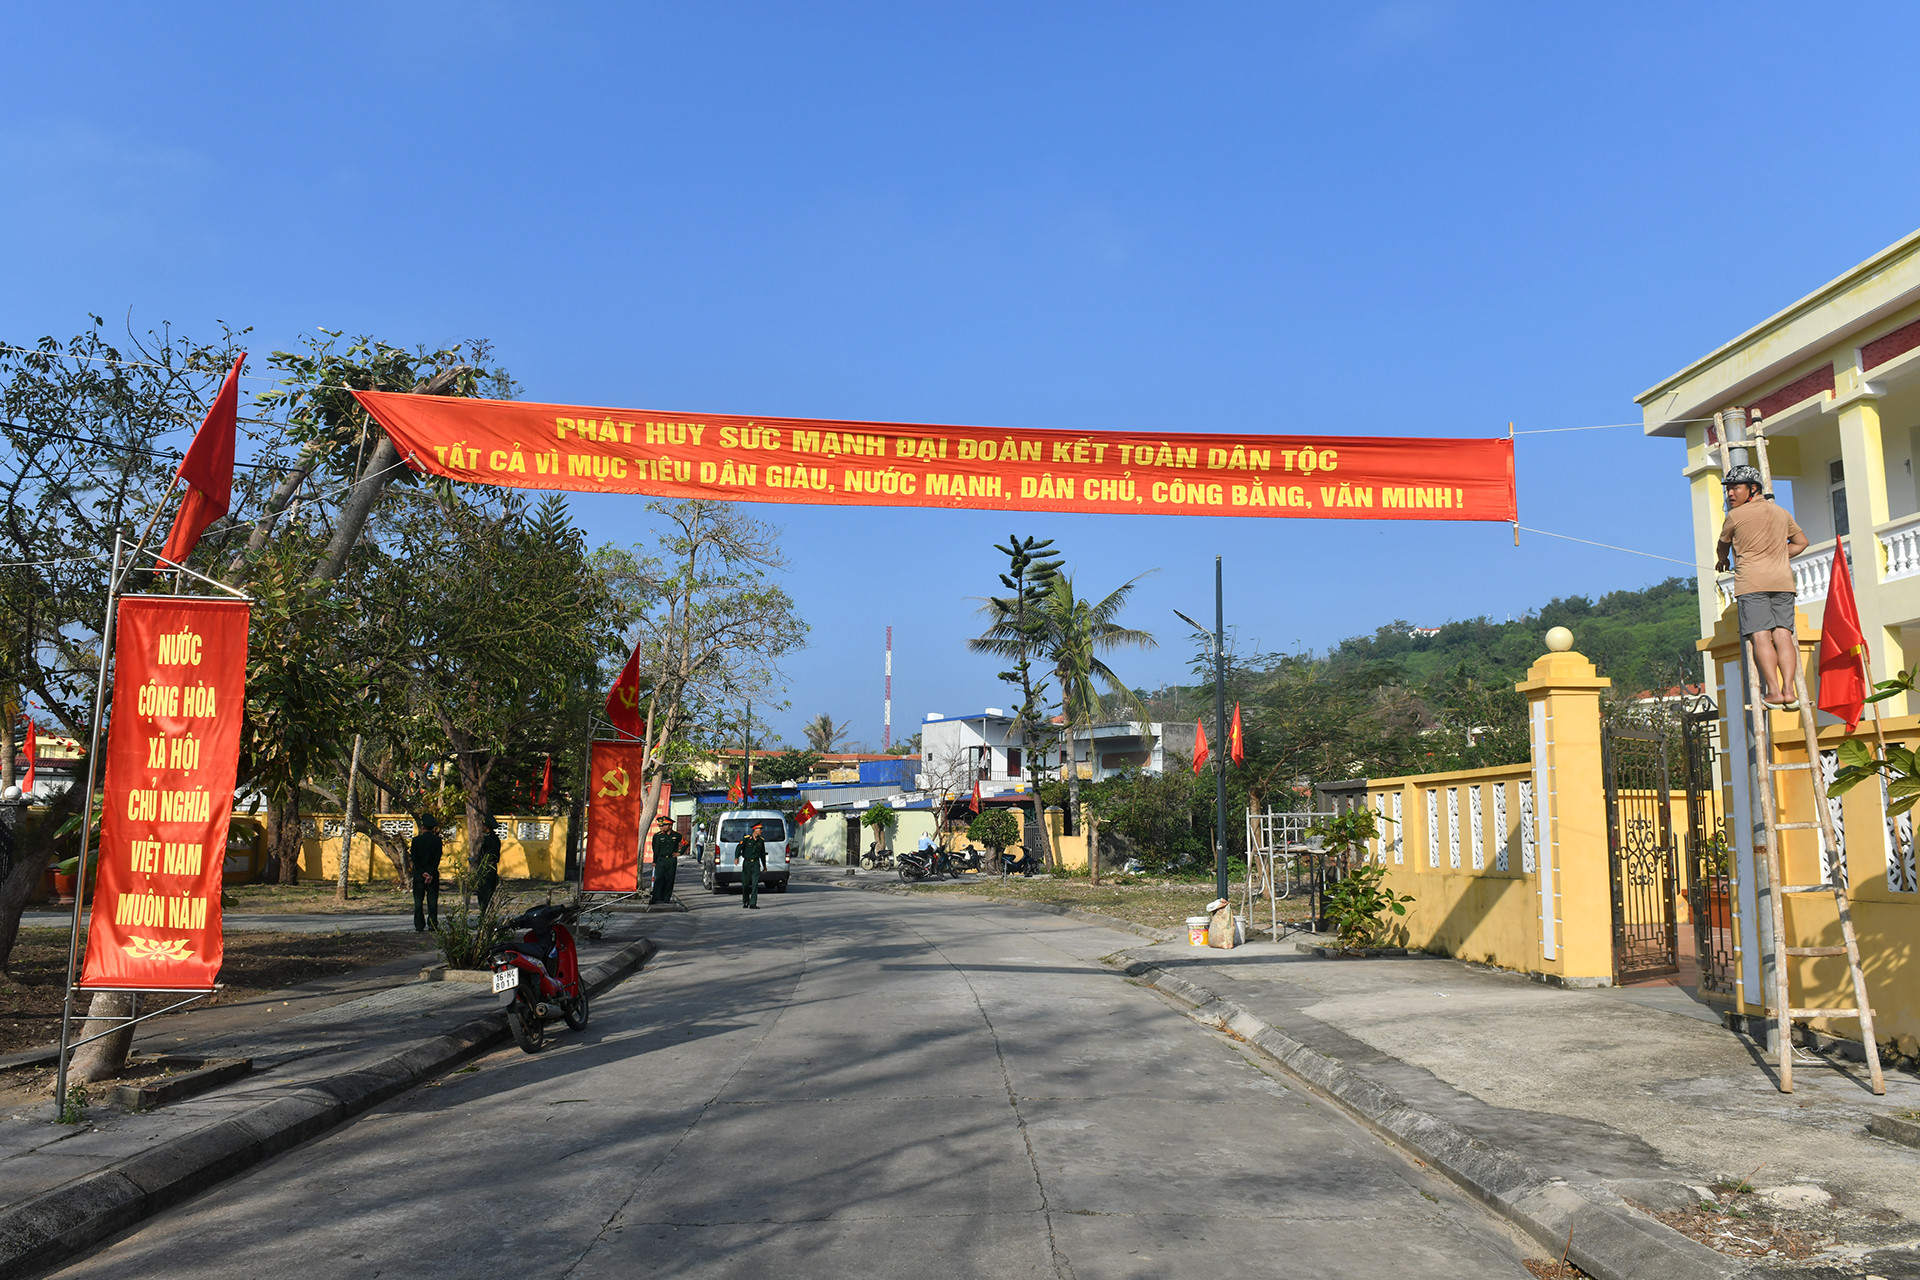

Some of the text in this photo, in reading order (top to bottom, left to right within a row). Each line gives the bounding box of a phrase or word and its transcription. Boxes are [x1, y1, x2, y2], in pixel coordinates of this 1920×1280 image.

[556, 416, 1338, 476] PHÁT HUY SỨC MẠNH ĐẠI ĐOÀN KẾT TOÀN DÂN TỘC
[433, 440, 1463, 509] TẤT CẢ VÌ MỤC TIÊU DÂN GIÀU, NƯỚC MẠNH, DÂN CHỦ, CÔNG BẰNG, VĂN MINH!
[158, 625, 202, 666] NƯỚC
[138, 679, 216, 723] CỘNG HÒA
[147, 732, 200, 777] XÃ HỘI
[127, 777, 210, 822] CHỦ NGHĨA
[131, 834, 202, 880] VIỆT NAM
[115, 888, 207, 930] MUÔN NĂM
[495, 978, 515, 990] 8011
